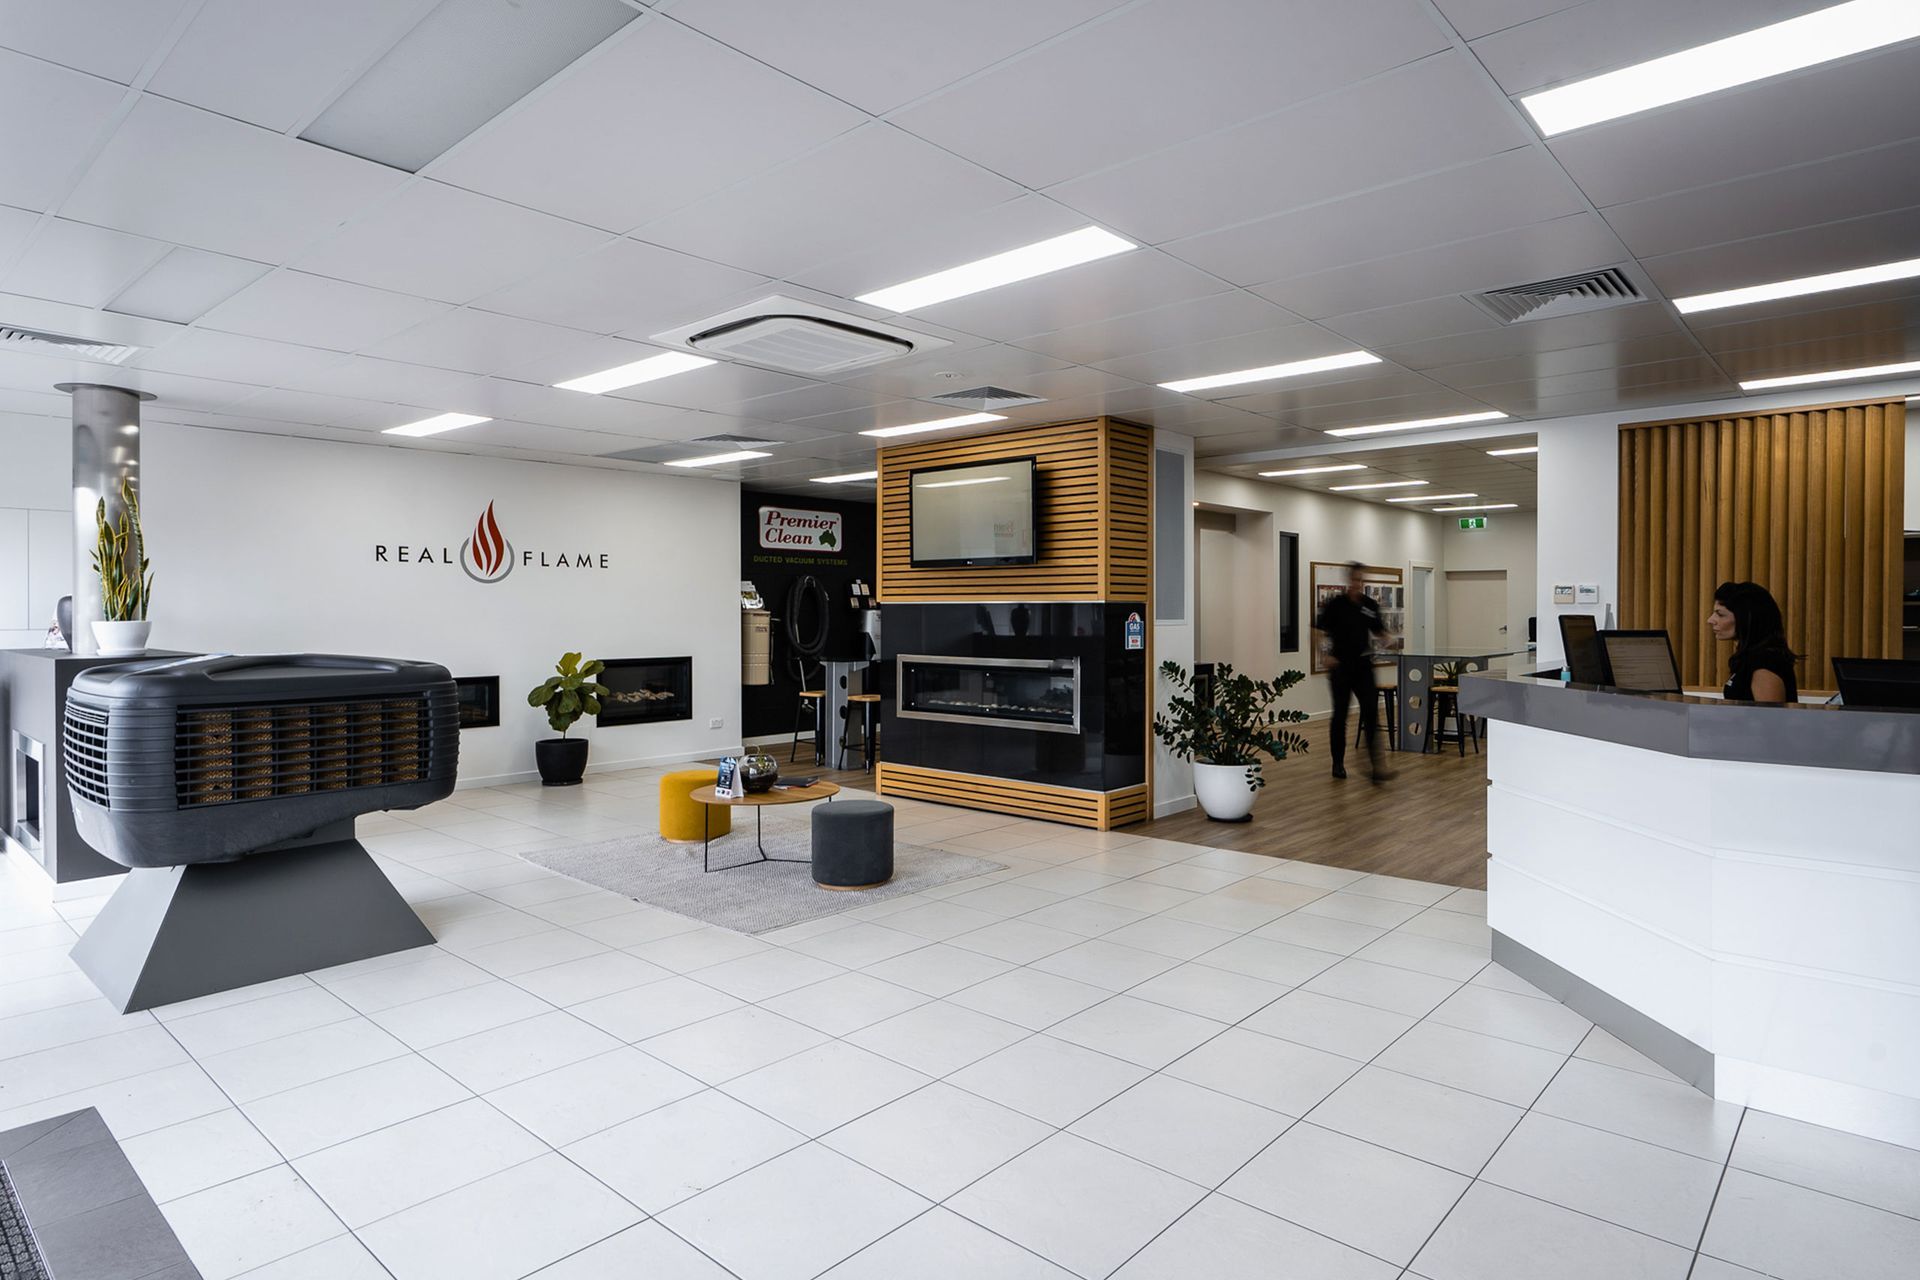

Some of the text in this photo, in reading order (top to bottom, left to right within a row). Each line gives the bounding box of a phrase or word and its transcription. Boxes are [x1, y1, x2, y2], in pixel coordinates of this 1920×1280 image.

[765, 511, 837, 529] Premier
[765, 528, 813, 544] Clean
[375, 545, 609, 569] REAL FLAME
[753, 555, 848, 566] DUCTED VACUUM SYSTEMS
